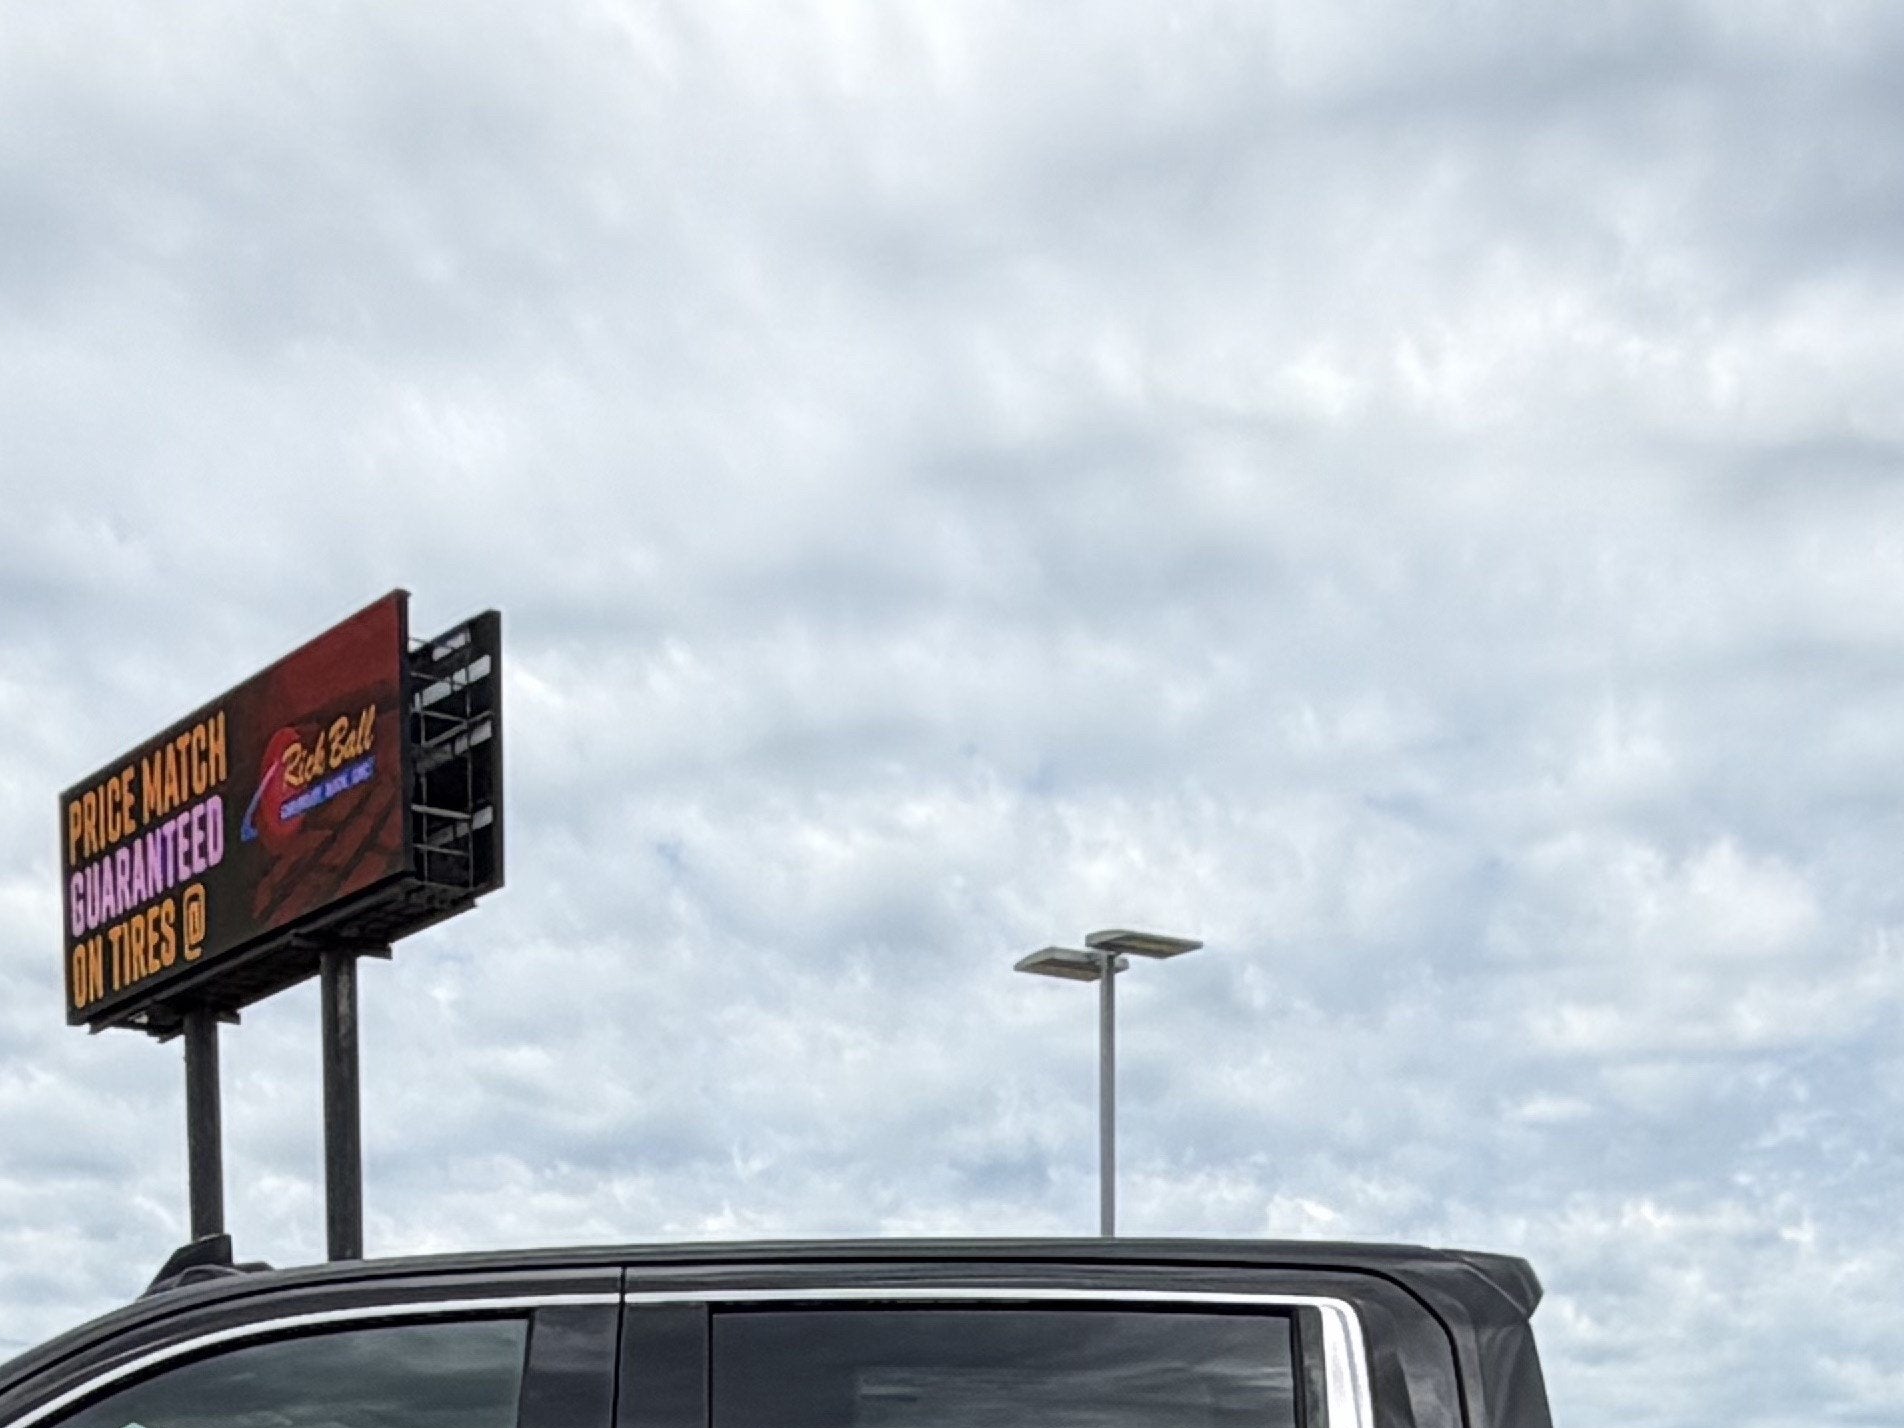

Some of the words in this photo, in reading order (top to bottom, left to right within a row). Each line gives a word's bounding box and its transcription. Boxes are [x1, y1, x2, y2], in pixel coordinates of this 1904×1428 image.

[69, 767, 138, 864] PRICE
[142, 711, 228, 826] MATCH
[282, 729, 328, 788] Rick
[329, 704, 377, 770] Ball
[70, 795, 225, 937] GUARANTEED
[73, 940, 104, 1008] ON
[110, 899, 177, 992] TIRES
[183, 883, 206, 960] @
